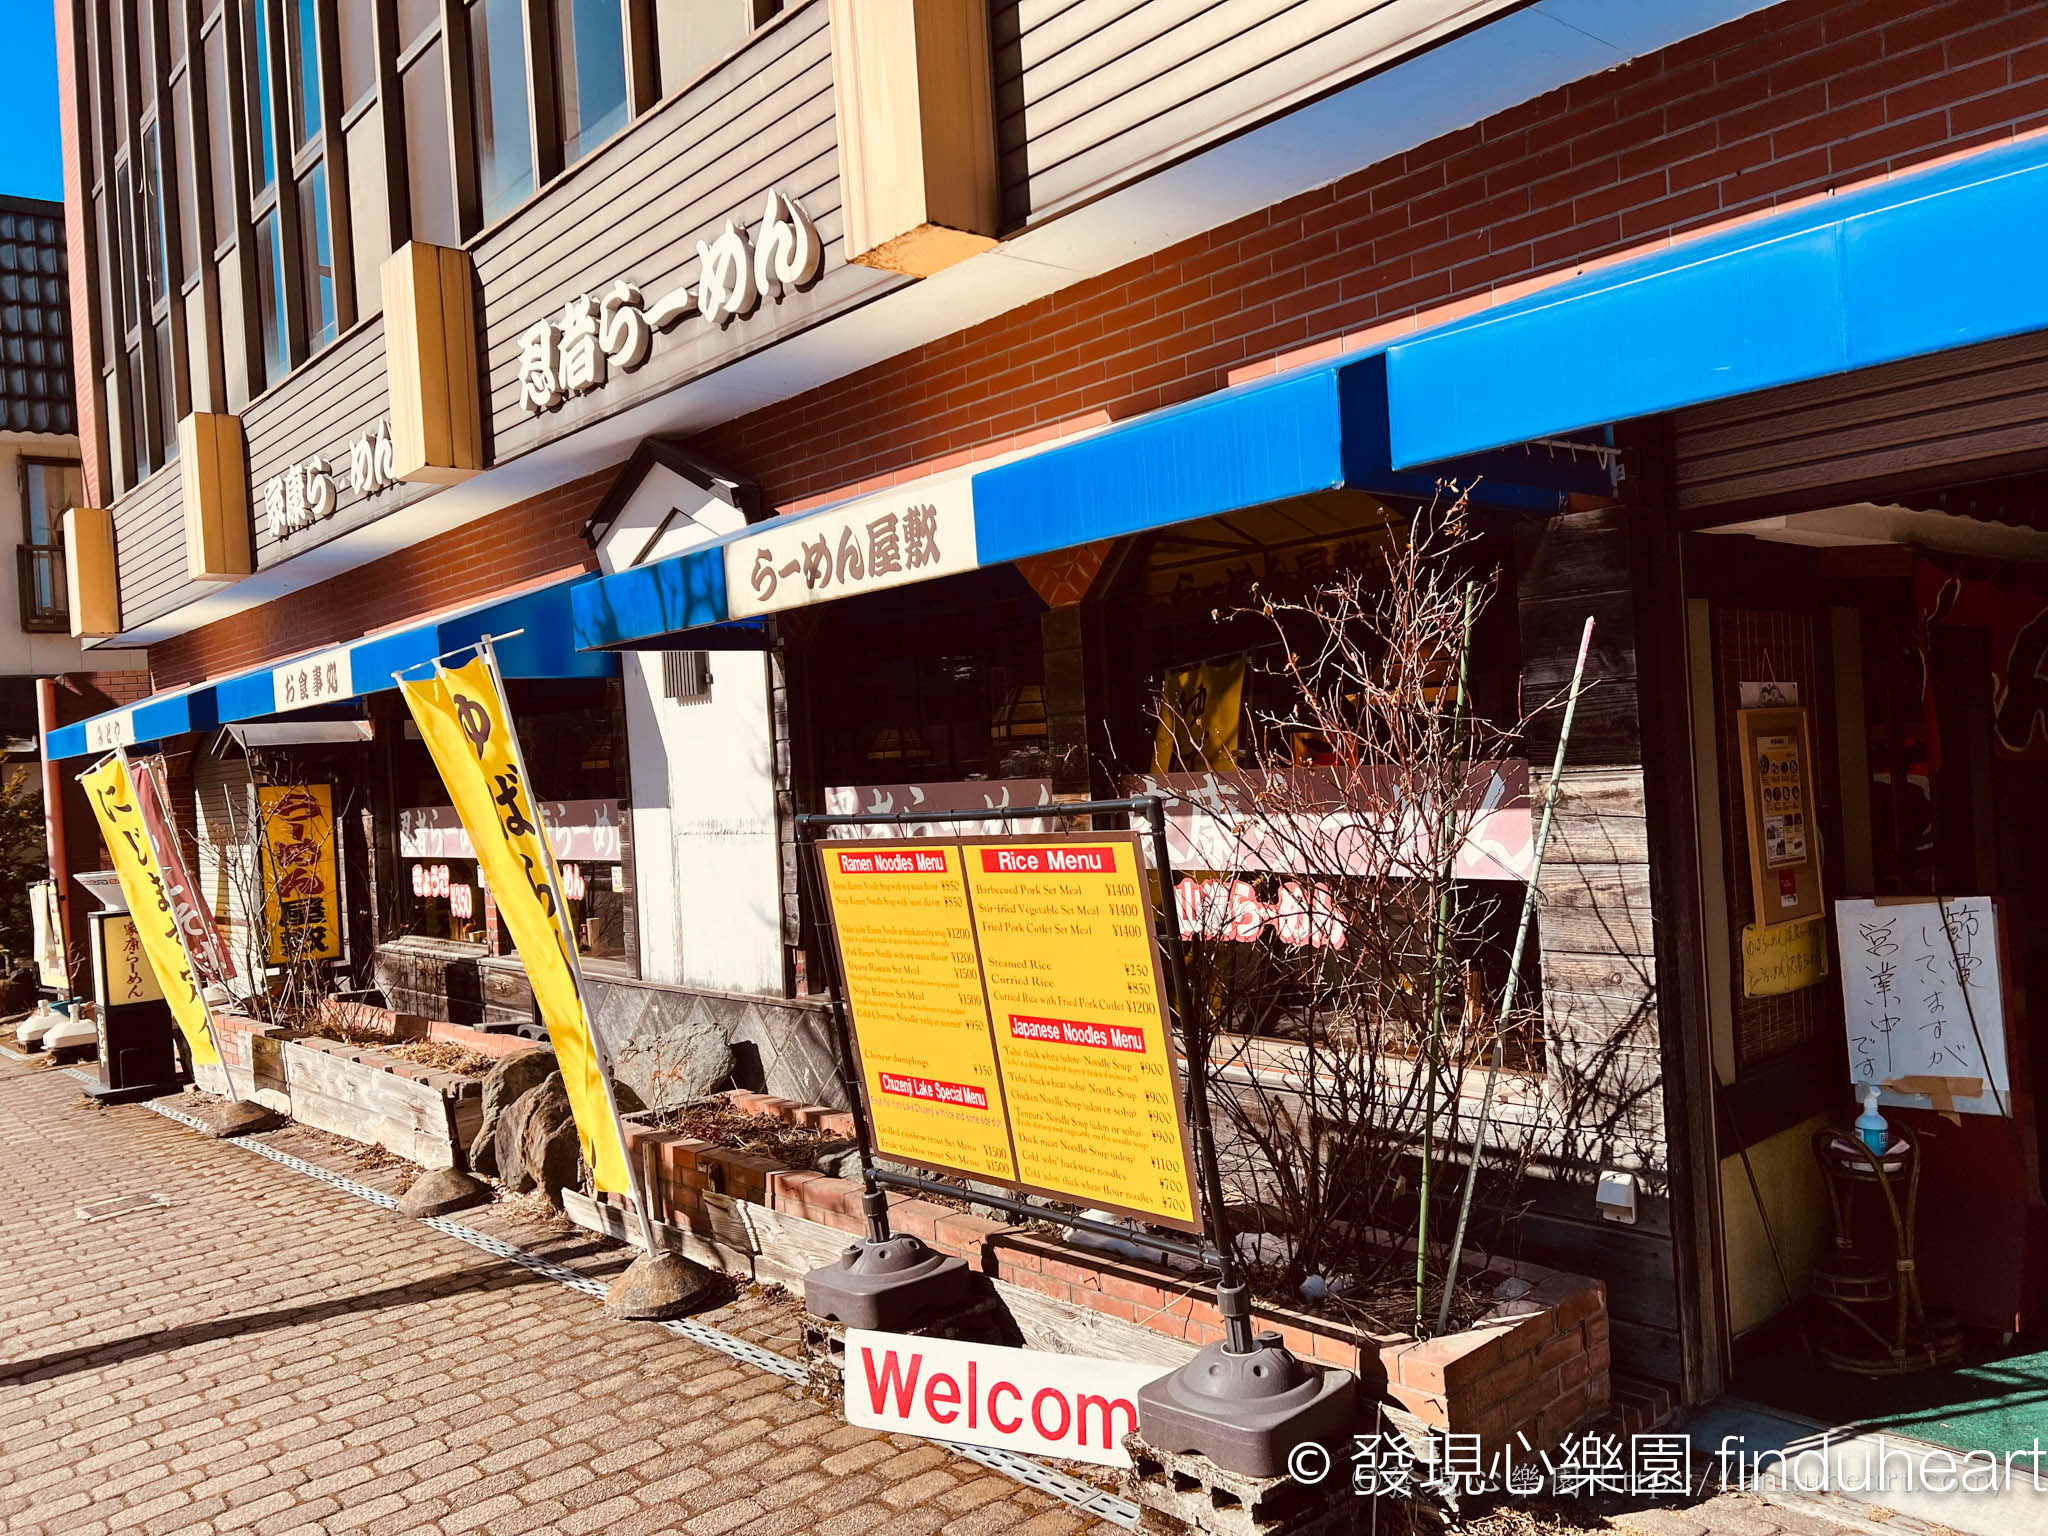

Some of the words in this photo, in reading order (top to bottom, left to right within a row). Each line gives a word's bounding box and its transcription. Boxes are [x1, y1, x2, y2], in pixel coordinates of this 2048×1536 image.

[751, 504, 941, 602] らーめん屋敷
[285, 660, 338, 704] お食事処
[841, 854, 872, 870] Ramen
[874, 854, 913, 870] Noodles
[916, 853, 943, 870] Menu
[998, 851, 1039, 869] Rice
[1047, 850, 1102, 869] Menu
[976, 884, 1017, 894] Barbecued
[1020, 885, 1040, 894] Pork
[1043, 885, 1056, 894] Set
[1059, 885, 1081, 895] Meal
[1018, 904, 1058, 916] Vegetable
[1060, 904, 1073, 914] Set
[1077, 905, 1099, 915] Meal
[982, 921, 1002, 931] Fried
[1005, 922, 1024, 932] Pork
[1026, 923, 1052, 933] Cutlet
[1054, 924, 1067, 933] Set
[1070, 924, 1092, 935] Meal
[868, 963, 890, 971] Ramen
[892, 964, 902, 972] Set
[904, 965, 919, 973] Meal
[988, 957, 1026, 968] Steamed
[1030, 960, 1051, 970] Rice
[1124, 963, 1148, 976] ¥250
[991, 973, 1028, 985] Curried
[1032, 976, 1054, 987] Rice
[1127, 981, 1151, 995] ¥850
[872, 988, 893, 997] Ramen
[895, 990, 905, 998] Set
[908, 991, 924, 1000] Meal
[993, 990, 1020, 1001] Curried
[1023, 993, 1038, 1003] Rice
[1040, 995, 1055, 1005] with
[1058, 996, 1076, 1007] Fried
[1079, 998, 1097, 1009] Pork
[1099, 1000, 1124, 1011] Cutlet
[1852, 918, 1901, 1079] 営業中です
[1914, 926, 1968, 1069] していますが
[1011, 1017, 1061, 1043] Japanese
[1063, 1023, 1107, 1044] Noodles
[1110, 1028, 1141, 1049] Menu
[864, 1049, 891, 1061] Chinese
[1084, 1055, 1110, 1068] Noodle
[1112, 1059, 1132, 1072] Soup
[882, 1074, 913, 1096] Chuzenji
[913, 1078, 933, 1097] Lake
[934, 1081, 963, 1105] Special
[963, 1086, 985, 1105] Menu
[1089, 1083, 1115, 1096] Noodle
[1117, 1087, 1136, 1100] Soup
[1040, 1093, 1062, 1106] Noodle
[1064, 1097, 1081, 1110] Soup
[1046, 1112, 1068, 1124] Noodle
[1071, 1116, 1088, 1129] Soup
[944, 1137, 954, 1146] Set
[1019, 1133, 1037, 1144] Duck
[1061, 1141, 1087, 1154] Noodle
[1089, 1147, 1107, 1159] Soup
[946, 1151, 955, 1161] Set
[1022, 1150, 1039, 1161] Cold
[1024, 1167, 1040, 1179] Cold
[861, 1347, 1137, 1449] Welcom
